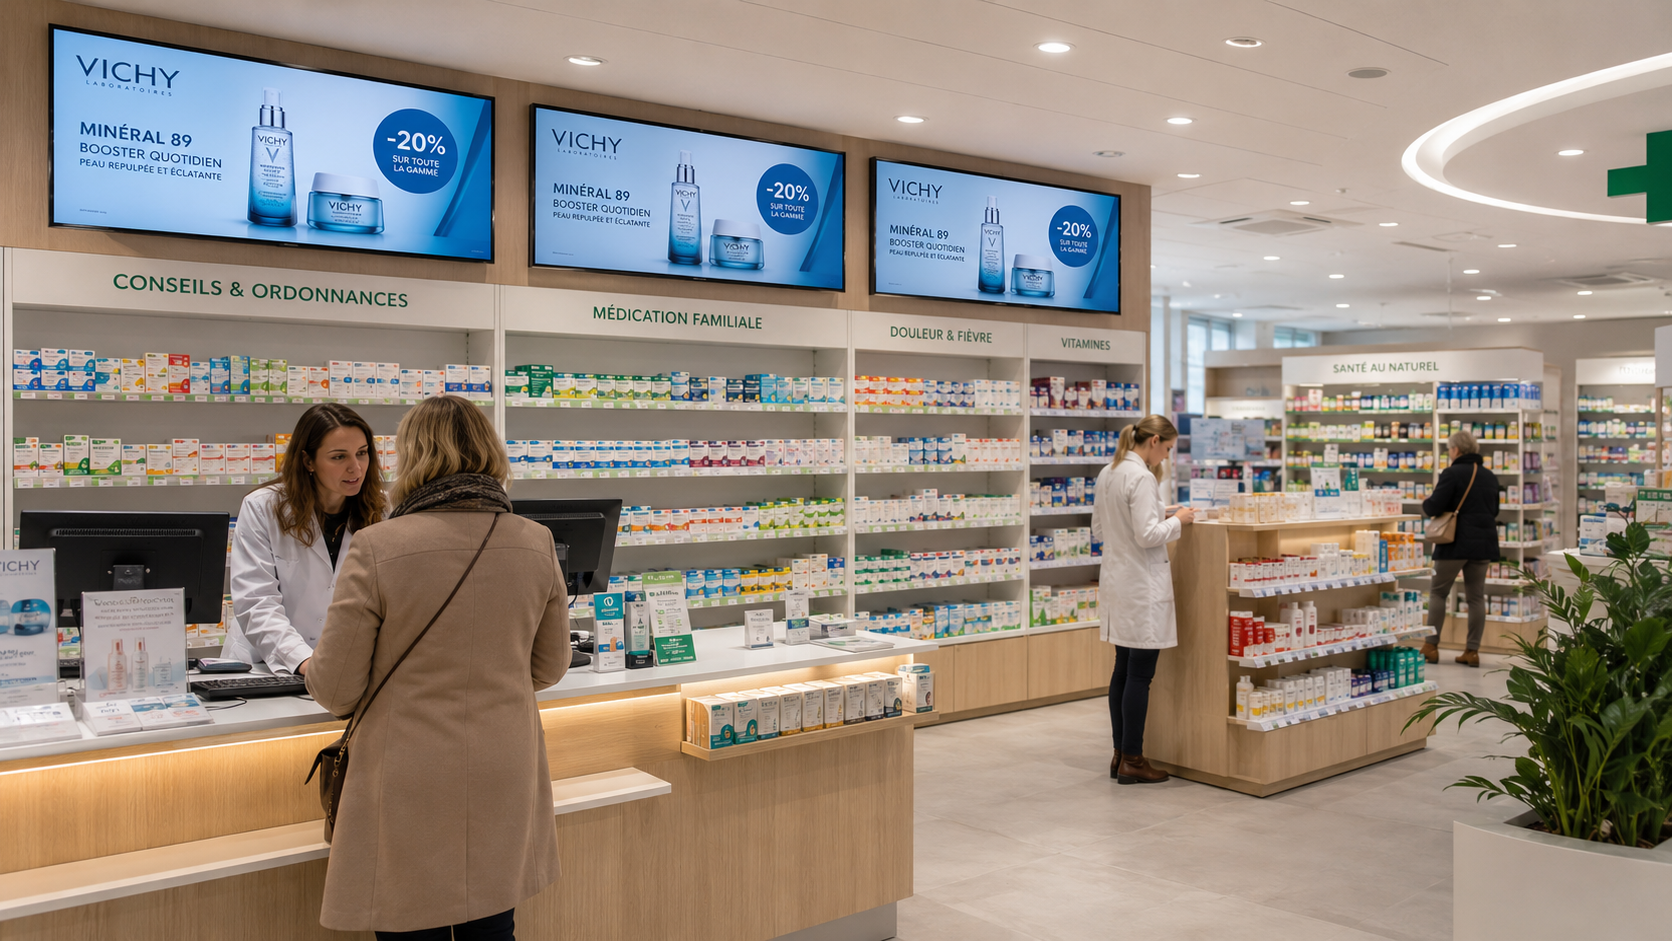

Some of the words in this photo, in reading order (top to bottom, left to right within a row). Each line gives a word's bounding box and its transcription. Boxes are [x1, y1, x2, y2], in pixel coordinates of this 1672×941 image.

[76, 54, 180, 89] VICHY
[86, 80, 172, 97] LABORATOIRES
[79, 121, 166, 145] MINÉRAL
[170, 133, 192, 148] 89
[257, 135, 288, 147] VICHY
[387, 130, 446, 155] -20%
[552, 128, 622, 154] VICHY
[79, 142, 146, 160] BOOSTER
[150, 150, 222, 168] QUOTIDIEN
[392, 155, 410, 164] SUR
[411, 157, 440, 168] TOUTE
[557, 148, 617, 160] LABORATOIRES
[79, 158, 106, 168] PEAU
[108, 161, 155, 174] REPULPÉE
[157, 166, 169, 175] ET
[170, 167, 222, 181] ÉCLATANTE
[393, 163, 404, 172] LA
[406, 166, 439, 177] GAMME
[553, 183, 611, 200] MINÉRAL
[615, 189, 630, 201] 89
[766, 181, 809, 202] -20%
[888, 177, 943, 199] VICHY
[328, 201, 362, 213] VICHY
[553, 199, 598, 212] BOOSTER
[601, 204, 651, 218] QUOTIDIEN
[553, 211, 571, 219] PEAU
[615, 217, 651, 228] ÉCLATANTE
[889, 224, 934, 239] MINÉRAL
[937, 229, 949, 240] 89
[1056, 221, 1092, 239] -20%
[889, 238, 924, 249] BOOSTER
[925, 242, 965, 253] QUOTIDIEN
[113, 273, 222, 297] CONSEILS
[229, 281, 245, 298] &
[252, 283, 408, 308] ORDONNANCES
[593, 304, 688, 325] MÉDICATION
[693, 313, 763, 330] FAMILIALE
[890, 325, 943, 341] DOULEUR
[946, 329, 955, 342] &
[957, 328, 993, 344] FIÈVRE
[1061, 337, 1111, 351] VITAMINES
[1333, 361, 1367, 374] SANTÉ
[1370, 363, 1386, 372] AU
[1389, 361, 1439, 373] NATUREL
[0, 560, 40, 572] ICHY
